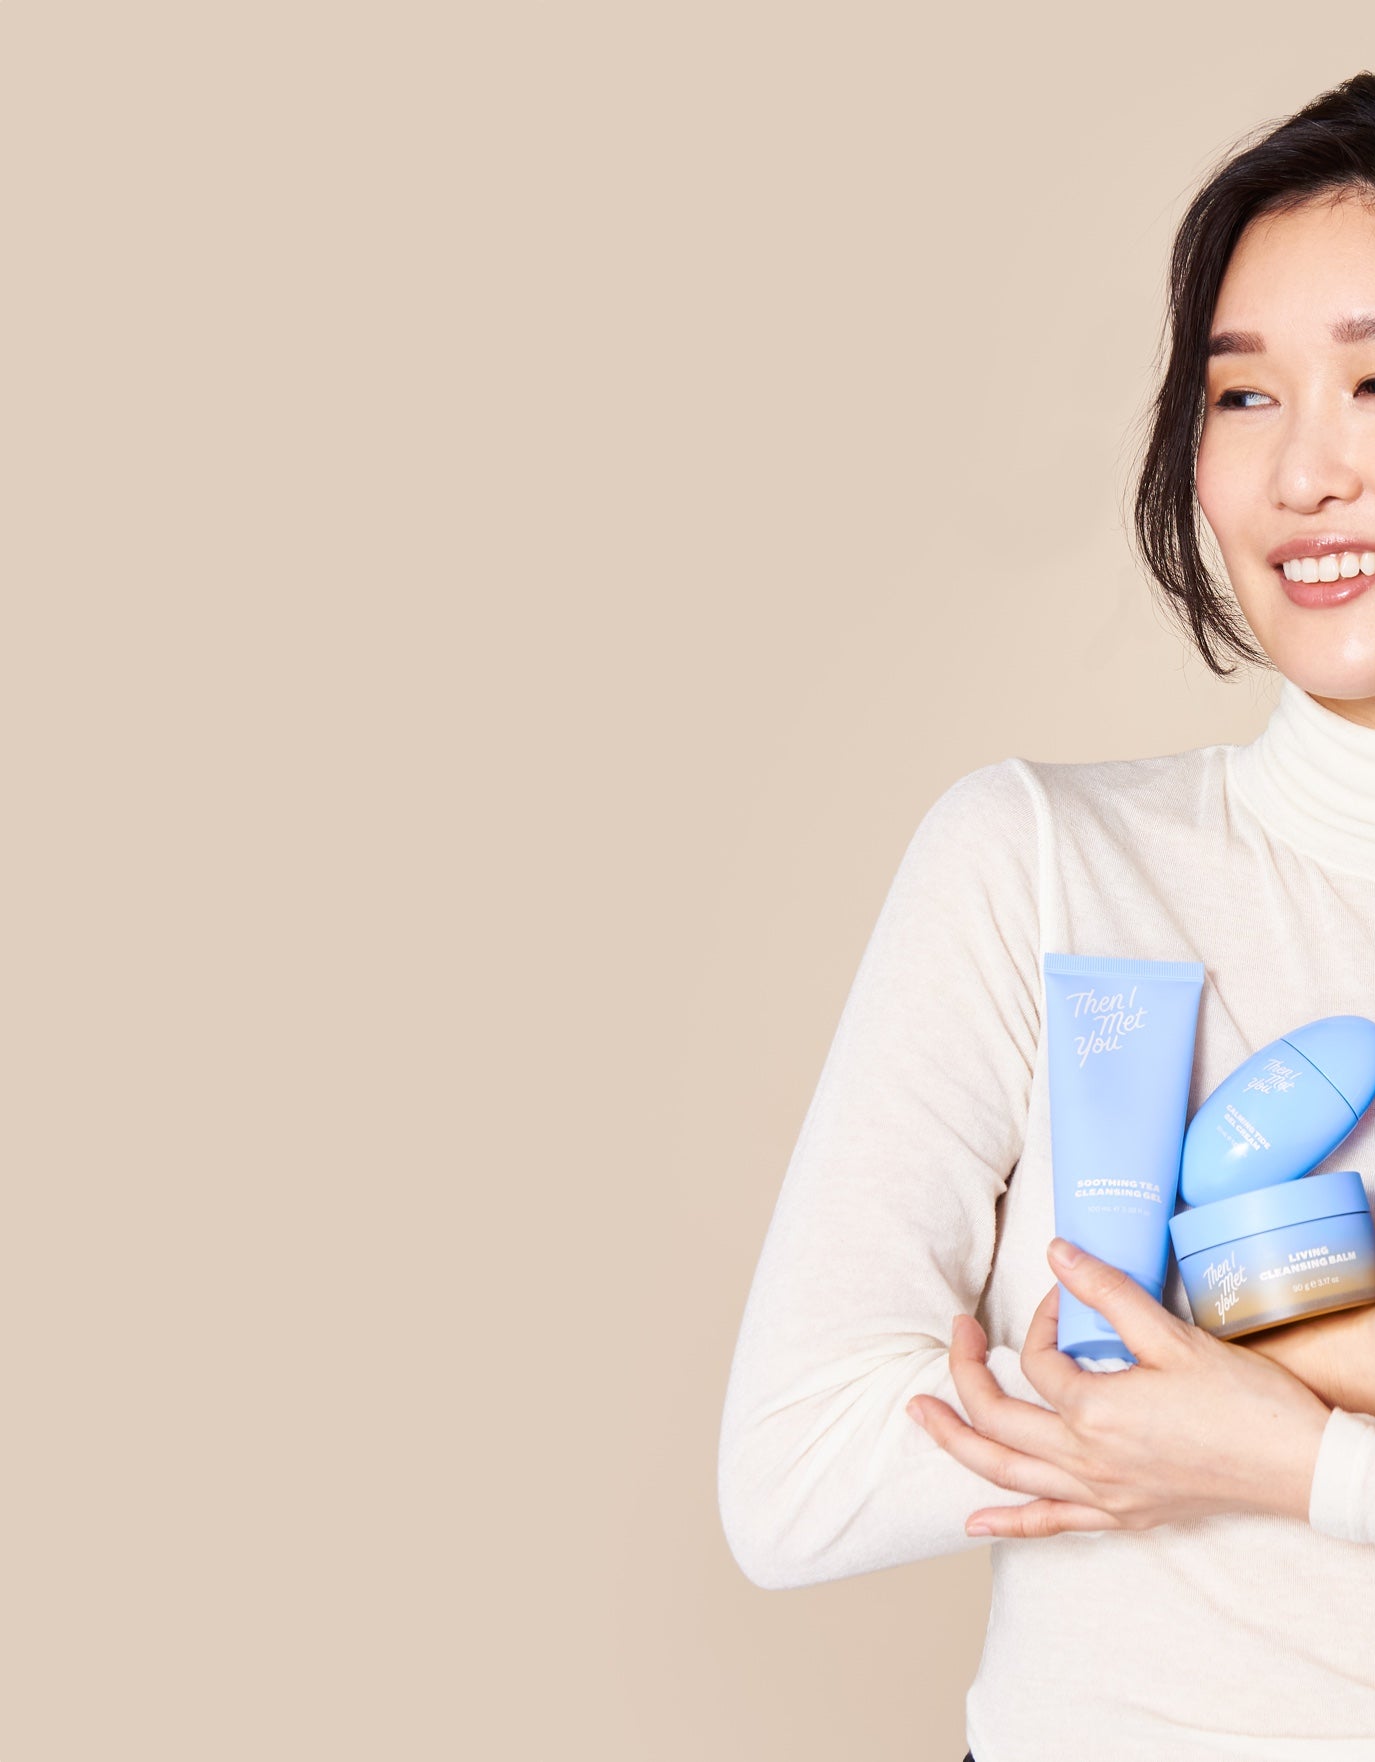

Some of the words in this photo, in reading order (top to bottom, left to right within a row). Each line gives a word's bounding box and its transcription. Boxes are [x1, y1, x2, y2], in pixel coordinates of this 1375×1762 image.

[1066, 988, 1125, 1018] Then
[1093, 1007, 1149, 1035] Met
[1074, 1030, 1123, 1068] You
[1235, 1124, 1260, 1151] CREAM
[1254, 1130, 1271, 1150] TIDE
[1074, 1188, 1142, 1198] CLEANSING
[1142, 1192, 1163, 1204] GEL
[1077, 1178, 1138, 1188] SOOTHING
[1139, 1181, 1160, 1192] TEA
[1259, 1256, 1328, 1281] CLEANSING
[1327, 1251, 1357, 1265] BALM
[1288, 1246, 1329, 1262] LIVING
[1203, 1263, 1232, 1290] Then
[1218, 1265, 1248, 1297] Met
[1215, 1290, 1240, 1326] You
